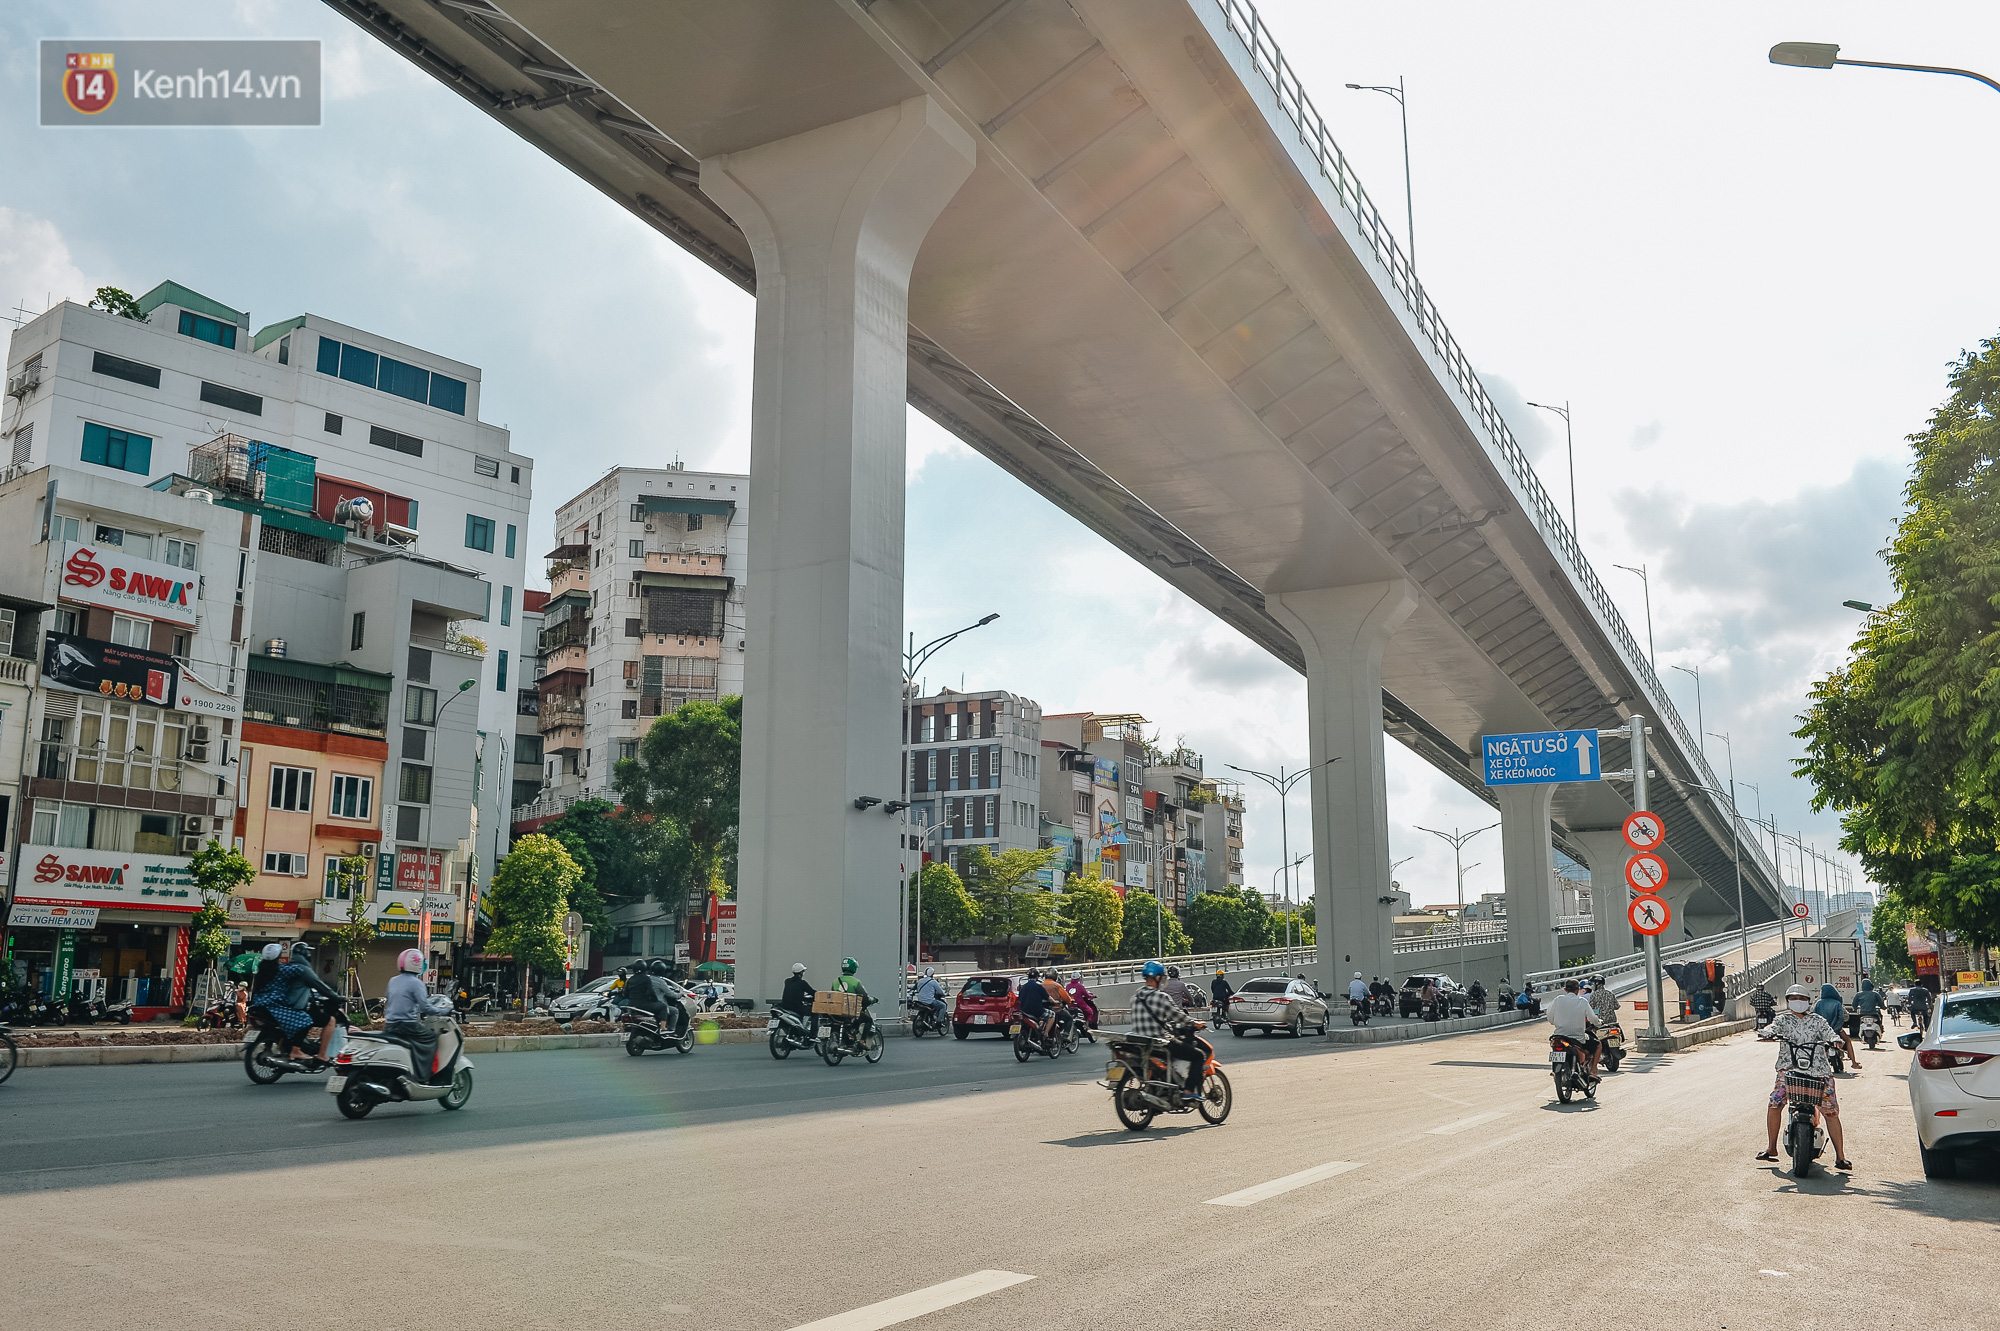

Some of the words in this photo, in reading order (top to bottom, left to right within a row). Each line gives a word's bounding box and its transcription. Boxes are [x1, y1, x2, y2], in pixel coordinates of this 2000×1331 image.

[110, 568, 187, 605] SAWA
[103, 588, 121, 599] Nâng
[137, 596, 147, 604] giá
[158, 601, 174, 609] cuộc
[176, 603, 192, 615] sống
[194, 699, 214, 708] 1900
[216, 703, 236, 712] 2296
[1488, 737, 1521, 756] NGÃ
[1521, 738, 1544, 754] TƯ
[1546, 733, 1568, 753] SỞ
[1489, 759, 1503, 768] XE
[1504, 757, 1511, 767] Ô
[1513, 756, 1527, 767] TÔ
[1490, 770, 1503, 780] XE
[1505, 766, 1525, 779] KÉO
[1527, 765, 1556, 778] MOÓC
[1131, 785, 1139, 795] SPA
[401, 852, 418, 863] CHO
[66, 864, 124, 885] SAWA
[144, 863, 165, 873] THIẾT
[404, 866, 415, 879] CẢ
[143, 875, 159, 884] MÁY
[160, 878, 174, 886] LỌC
[12, 913, 32, 923] XÉT
[34, 916, 71, 926] NGHIỆM
[73, 918, 93, 926] ADN
[379, 920, 397, 931] SÀN
[398, 920, 409, 932] GỖ
[431, 923, 451, 934] HIÊM
[59, 958, 69, 995] Kangaroo
